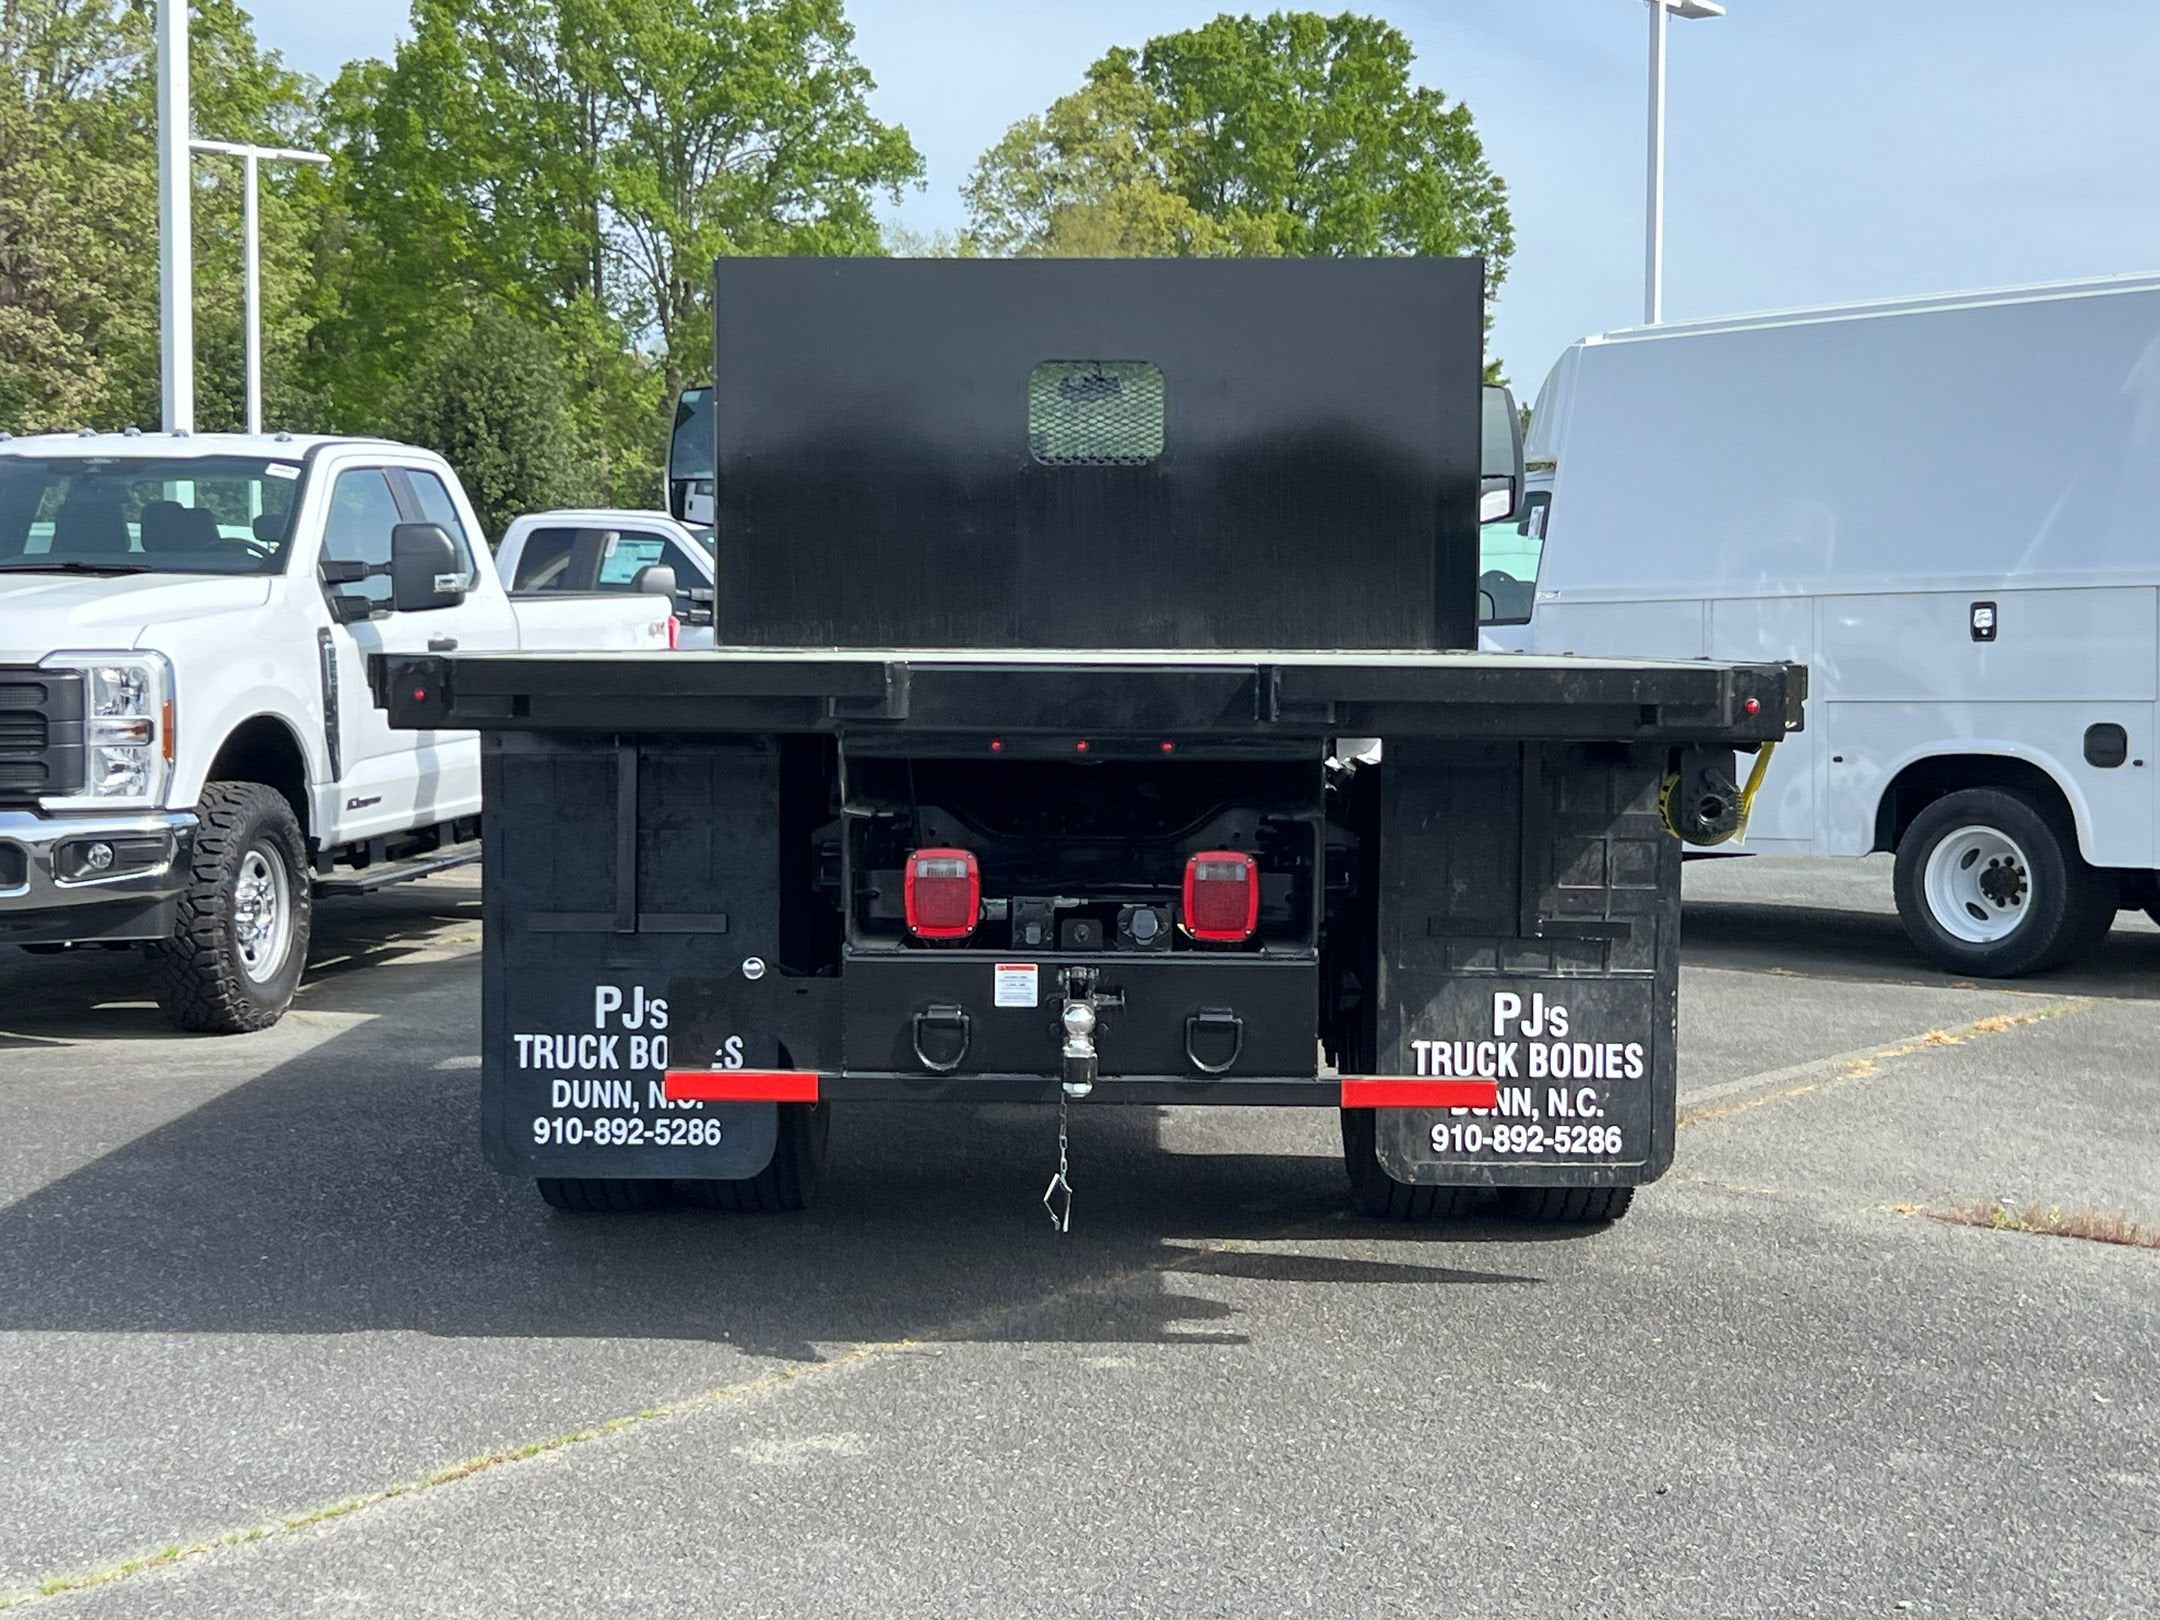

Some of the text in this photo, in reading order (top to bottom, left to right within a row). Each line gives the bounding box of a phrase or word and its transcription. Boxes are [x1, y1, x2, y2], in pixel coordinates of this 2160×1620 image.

[595, 985, 668, 1030] PJ's
[1493, 992, 1569, 1038] PJ's
[513, 1034, 744, 1070] TRUCK BOS
[1411, 1040, 1644, 1079] TRUCK BODIES
[552, 1080, 640, 1114] DUNN,
[1449, 1088, 1604, 1121] NN, N.C.
[533, 1117, 722, 1146] 910-892-5286
[1431, 1124, 1622, 1154] 910-892-5286
